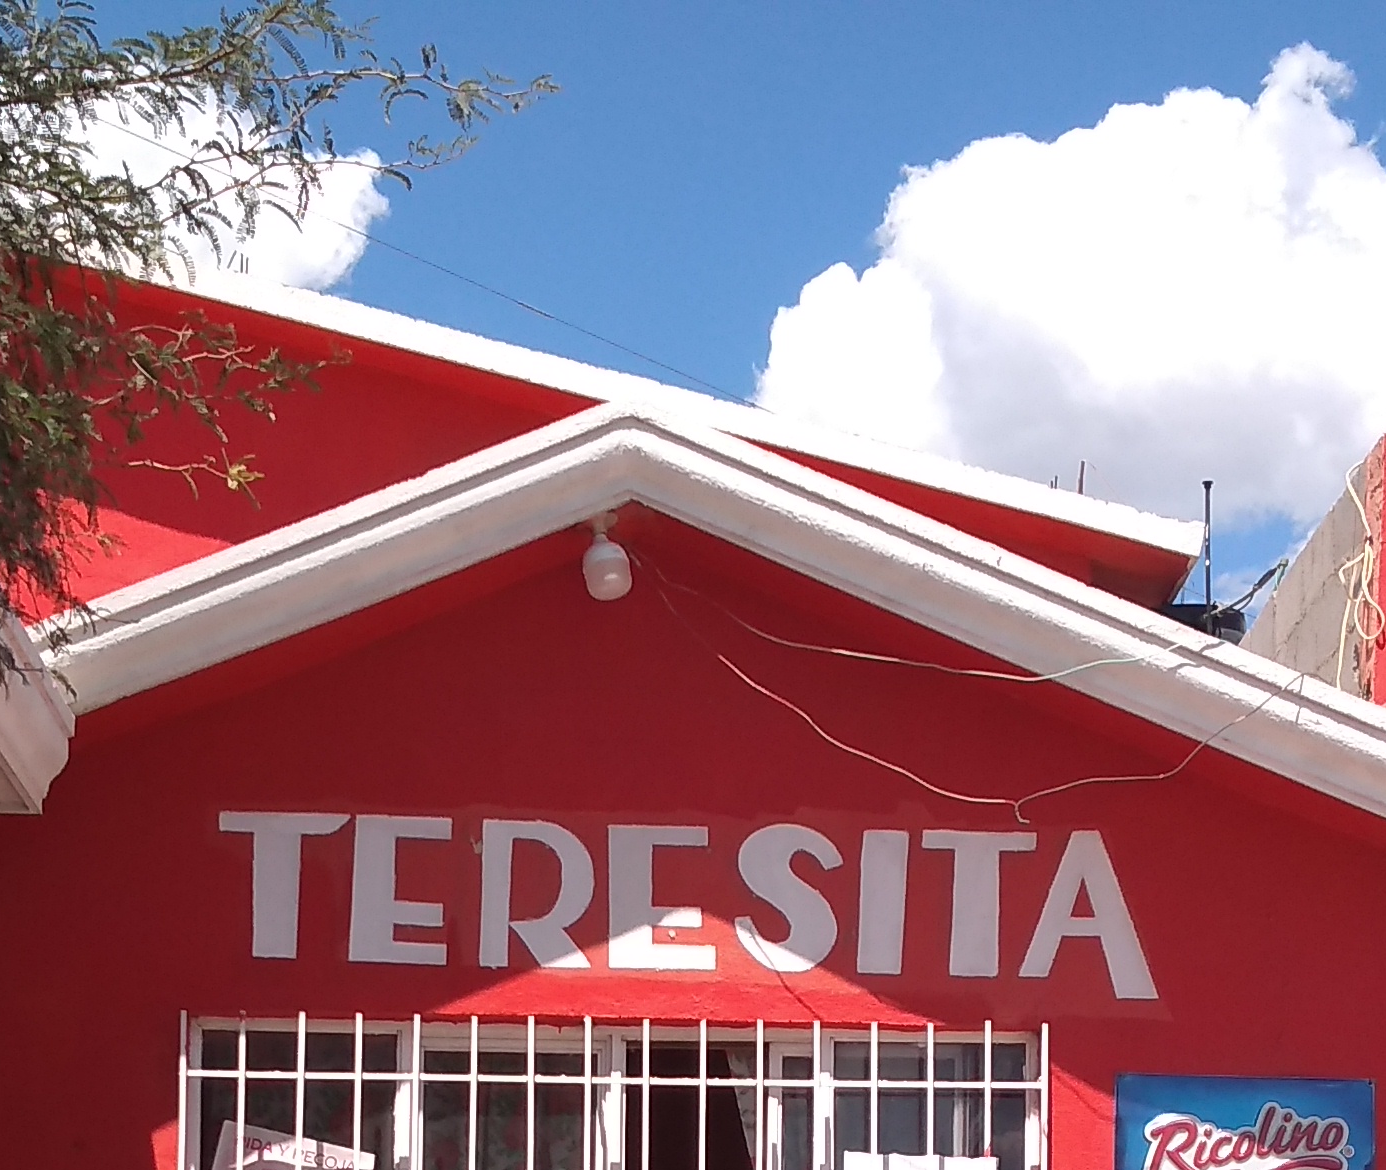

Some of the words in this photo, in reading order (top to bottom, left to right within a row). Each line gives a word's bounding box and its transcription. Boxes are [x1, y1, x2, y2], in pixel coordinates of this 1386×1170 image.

[218, 811, 1159, 999] TERESITA
[238, 1135, 273, 1154] IDA
[278, 1143, 290, 1157] Y
